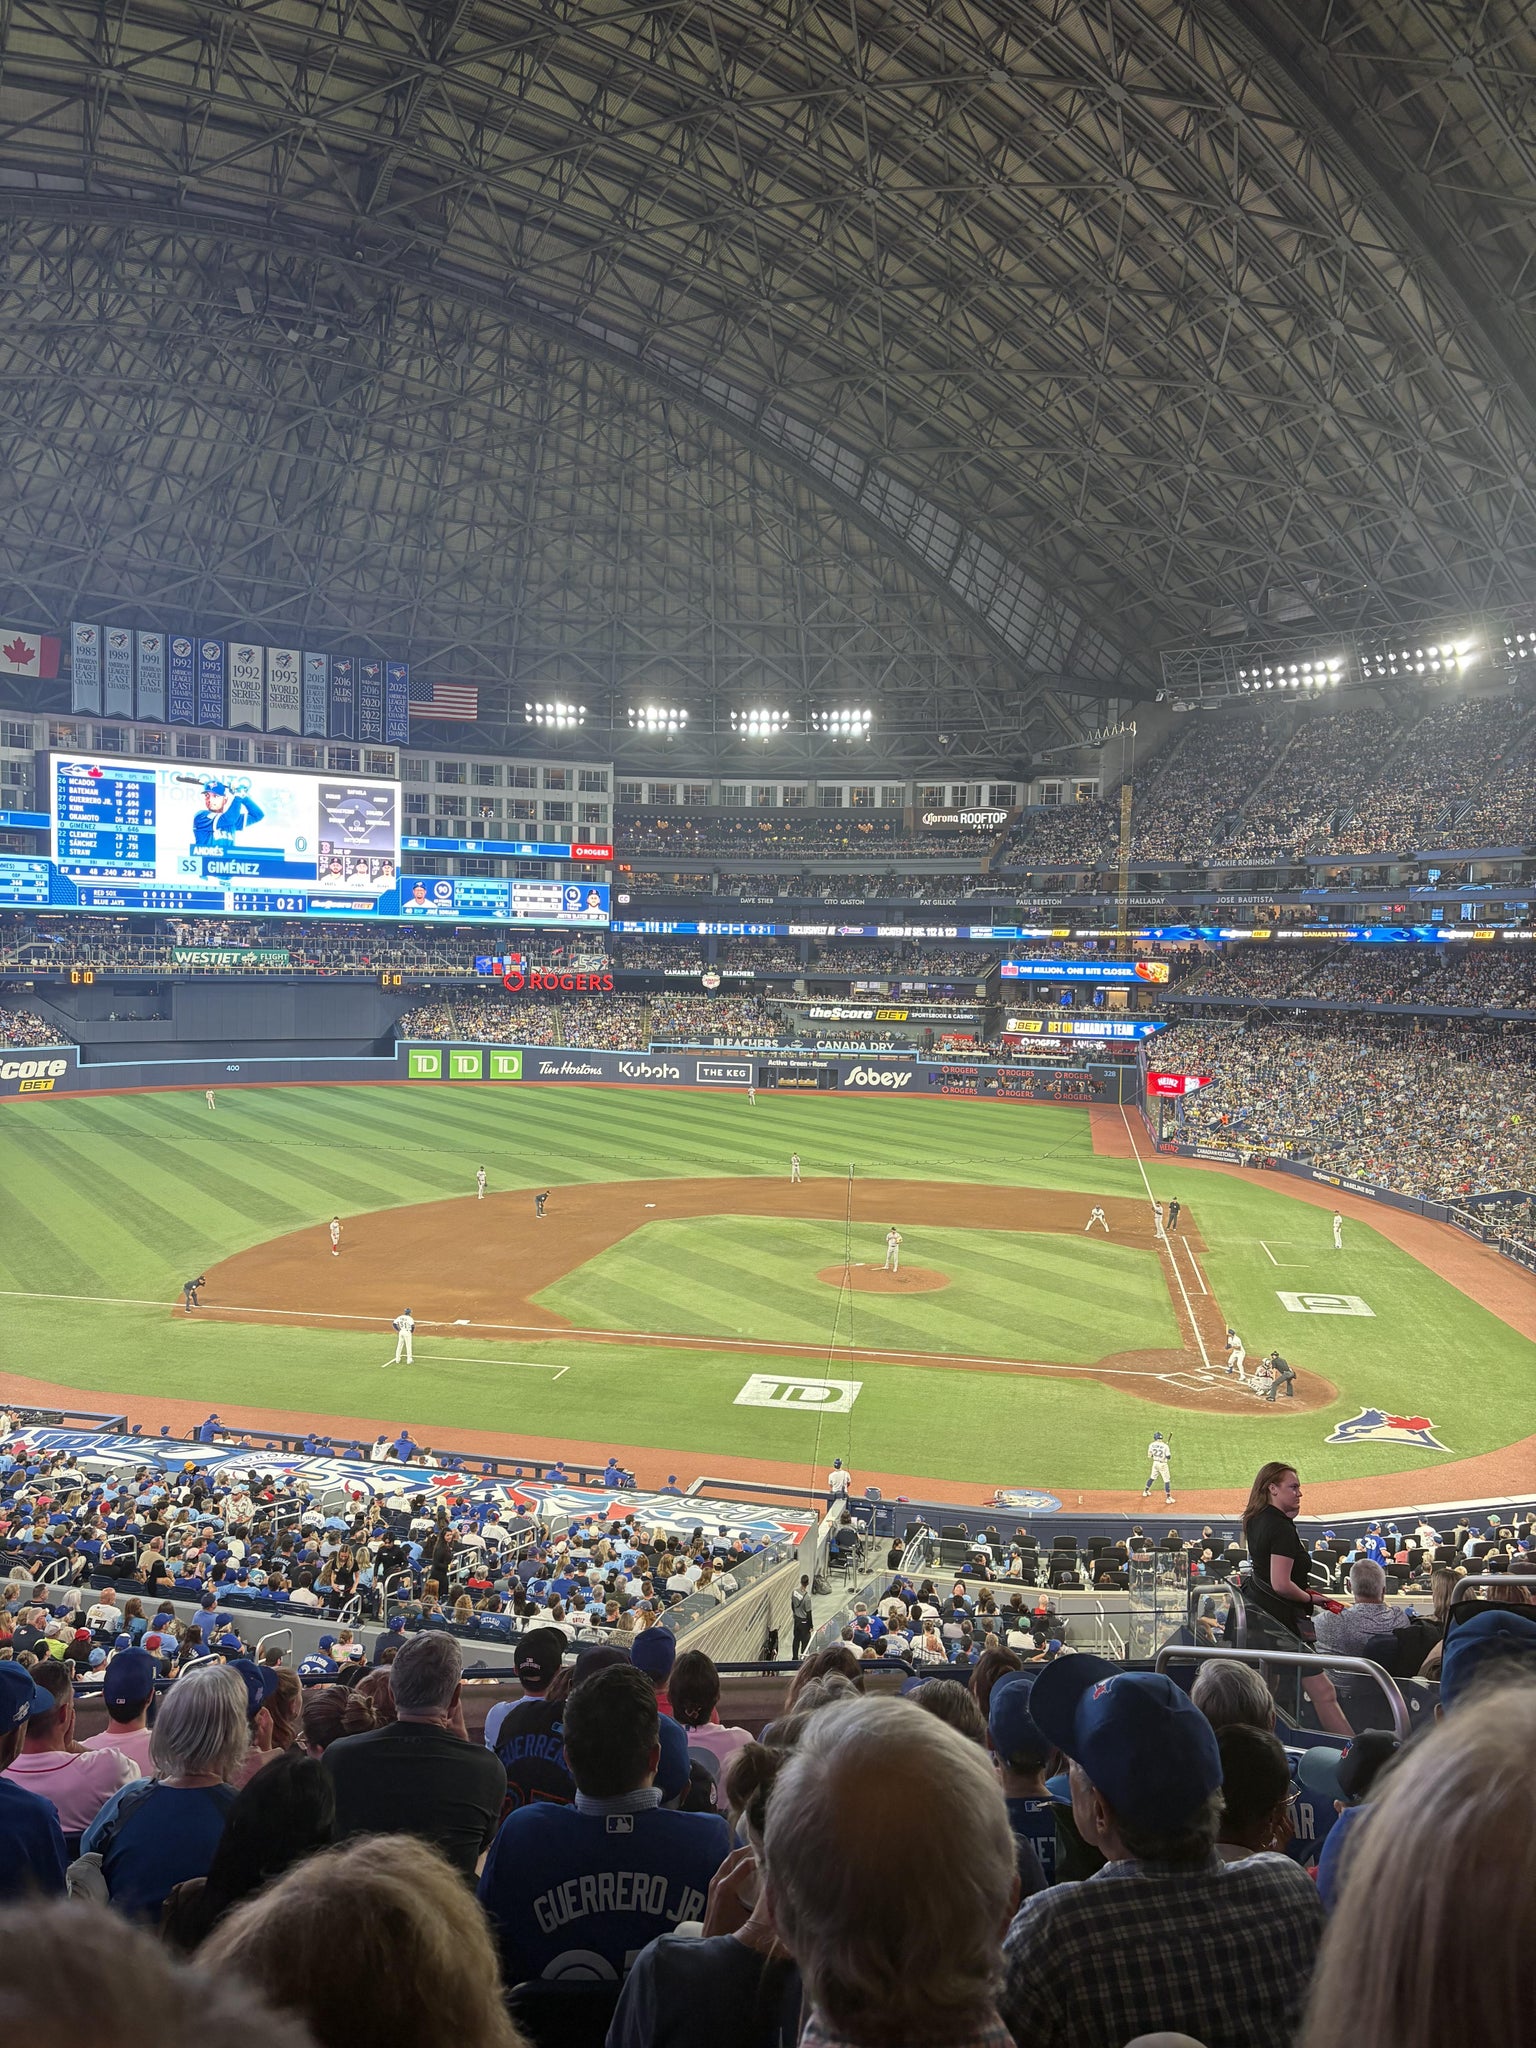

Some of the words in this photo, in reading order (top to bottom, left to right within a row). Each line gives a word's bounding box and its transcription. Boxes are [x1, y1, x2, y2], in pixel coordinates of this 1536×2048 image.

[76, 646, 97, 657] 1985
[109, 650, 129, 660] 1989
[142, 655, 160, 664] 1991
[172, 658, 192, 668] 1992
[75, 663, 98, 671] LEAGUE
[108, 667, 129, 675] LEAGUE
[202, 662, 220, 672] 1993
[75, 671, 97, 680] EAST
[233, 665, 260, 680] 1992
[271, 670, 298, 684] 1993
[108, 675, 130, 684] EAST
[140, 678, 161, 687] EAST
[307, 674, 324, 682] 2015
[334, 676, 350, 686] 2016
[172, 682, 192, 691] EAST
[201, 684, 221, 694] EAST
[232, 680, 260, 690] WORLD
[270, 684, 298, 694] WORLD
[362, 686, 379, 694] 2016
[389, 683, 406, 692] 2025
[232, 690, 260, 700] SERIES
[270, 694, 298, 704] SERIES
[306, 696, 324, 704] EAST
[172, 700, 192, 710] ALCS
[232, 698, 261, 706] CHAMPIONS
[362, 698, 380, 708] 2020
[202, 703, 221, 712] ALCS
[388, 705, 406, 713] EAST
[362, 710, 380, 720] 2022
[362, 723, 380, 732] 2023
[389, 722, 407, 731] ALCS
[69, 778, 96, 786] MCADOO
[69, 787, 98, 795] BATEMAN
[69, 796, 102, 804] GUERRERO
[69, 814, 100, 822] OKAMOTO
[922, 813, 958, 826] Corona
[960, 812, 1008, 824] ROOFTOP
[70, 821, 96, 830] GIMÉNEZ
[70, 839, 98, 848] SÁNCHEZ
[193, 846, 224, 856] ANDRÉS
[182, 860, 196, 872] SS
[207, 859, 260, 875] GIMÉNEZ
[1212, 859, 1237, 867] JACKIE
[1238, 858, 1276, 866] ROBINSON
[789, 926, 824, 935] EXCLUSIVELY
[878, 927, 904, 936] LOCATED
[904, 927, 912, 936] AT
[926, 927, 937, 936] 112
[945, 928, 957, 936] 123
[175, 952, 240, 964] WESTJET
[529, 974, 614, 990] ROGERS
[810, 1008, 873, 1020] theScore
[878, 1012, 906, 1020] BET
[1048, 1022, 1061, 1032] BET
[1062, 1023, 1072, 1032] ON
[1074, 1023, 1112, 1035] CANADA'S
[713, 1038, 779, 1048] BLEACHERS
[816, 1040, 866, 1050] CANADA
[870, 1042, 894, 1050] DRY
[412, 1055, 438, 1073] TD
[452, 1055, 479, 1074] TD
[493, 1056, 520, 1074] TD
[538, 1061, 558, 1074] Tim
[559, 1061, 602, 1075] Hortons
[0, 1059, 67, 1080] core
[618, 1062, 680, 1078] Kubota
[704, 1068, 724, 1076] THE
[726, 1070, 746, 1078] KEG
[844, 1066, 912, 1088] Sobeys
[1158, 1077, 1178, 1087] HEINZ
[23, 1080, 52, 1090] BET
[1160, 1144, 1178, 1153] HEINZ
[1343, 1182, 1364, 1192] BASELINE
[1365, 1188, 1375, 1196] BOX
[760, 1381, 844, 1404] TD
[1153, 1449, 1163, 1458] 22
[1365, 1537, 1377, 1550] 29
[533, 1872, 668, 1934] GUERRERO
[666, 1886, 706, 1922] JR
